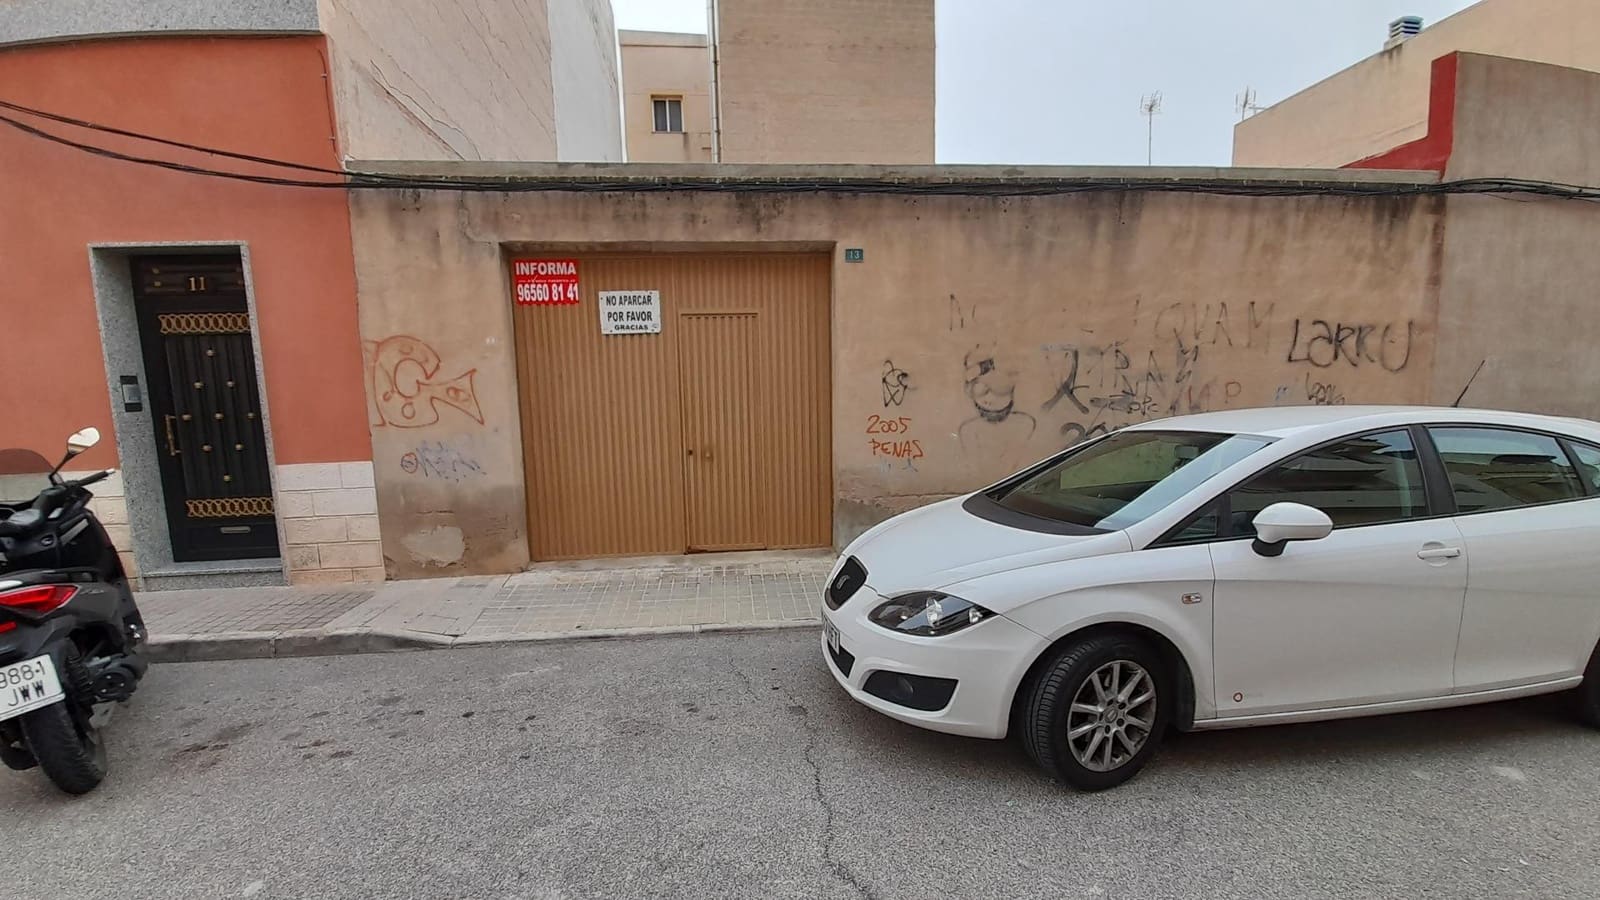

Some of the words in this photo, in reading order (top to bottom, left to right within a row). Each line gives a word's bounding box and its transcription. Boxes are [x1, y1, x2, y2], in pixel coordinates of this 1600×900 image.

[515, 262, 577, 276] INFORMA
[189, 277, 205, 291] 11
[517, 283, 549, 302] 96560
[551, 283, 564, 301] 81
[567, 283, 579, 301] 41
[606, 295, 617, 306] NO
[619, 295, 653, 306] APARCAR
[607, 311, 624, 322] POR
[626, 310, 653, 322] FAVOR
[866, 414, 912, 434] 2005
[868, 438, 924, 459] PENAS
[8, 680, 46, 707] JWW
